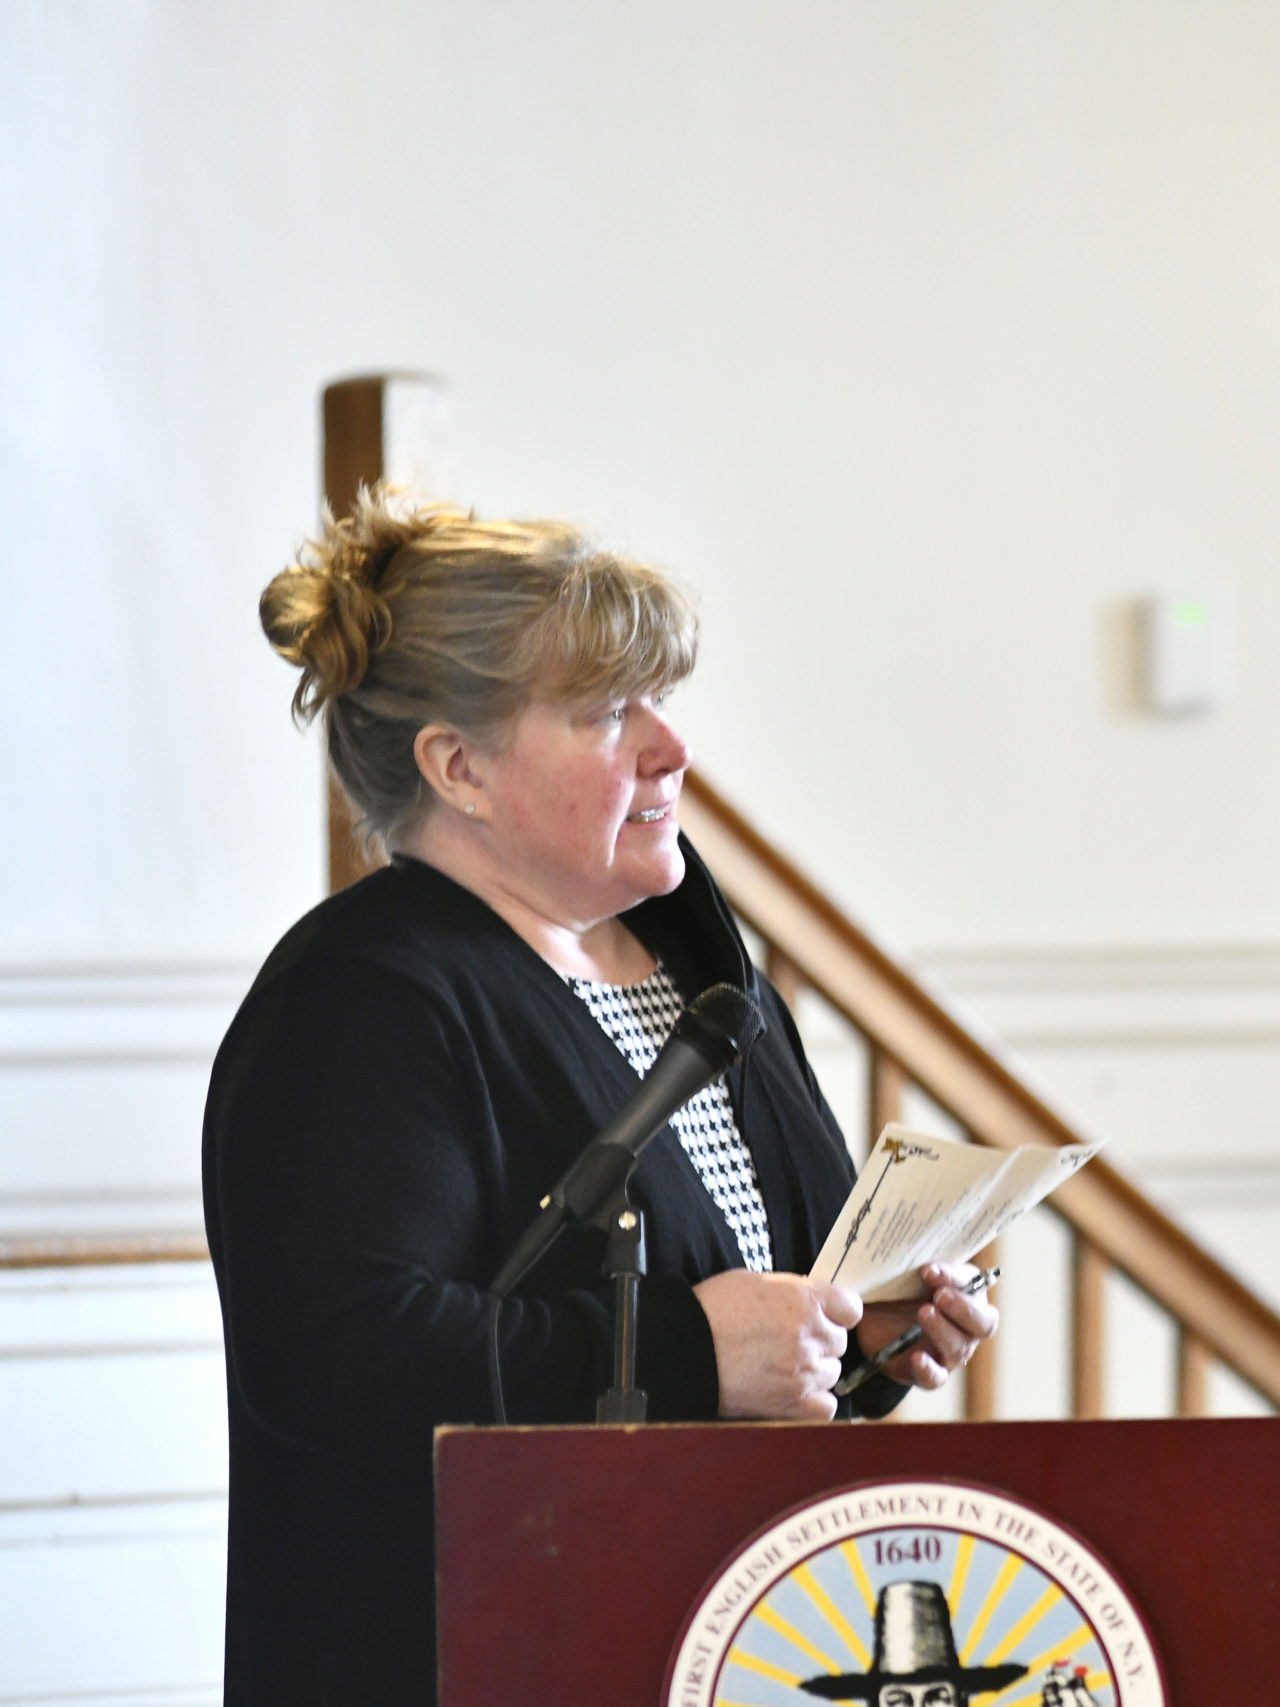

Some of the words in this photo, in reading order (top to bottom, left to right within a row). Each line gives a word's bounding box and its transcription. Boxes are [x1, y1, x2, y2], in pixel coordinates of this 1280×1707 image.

[704, 1544, 783, 1635] ENGLISH
[786, 1497, 947, 1545] SETTLEMENT
[957, 1501, 984, 1521] IN
[994, 1513, 1040, 1543] THE
[1046, 1542, 1101, 1596] STATE
[1100, 1603, 1125, 1630] OF
[873, 1535, 941, 1567] 1640
